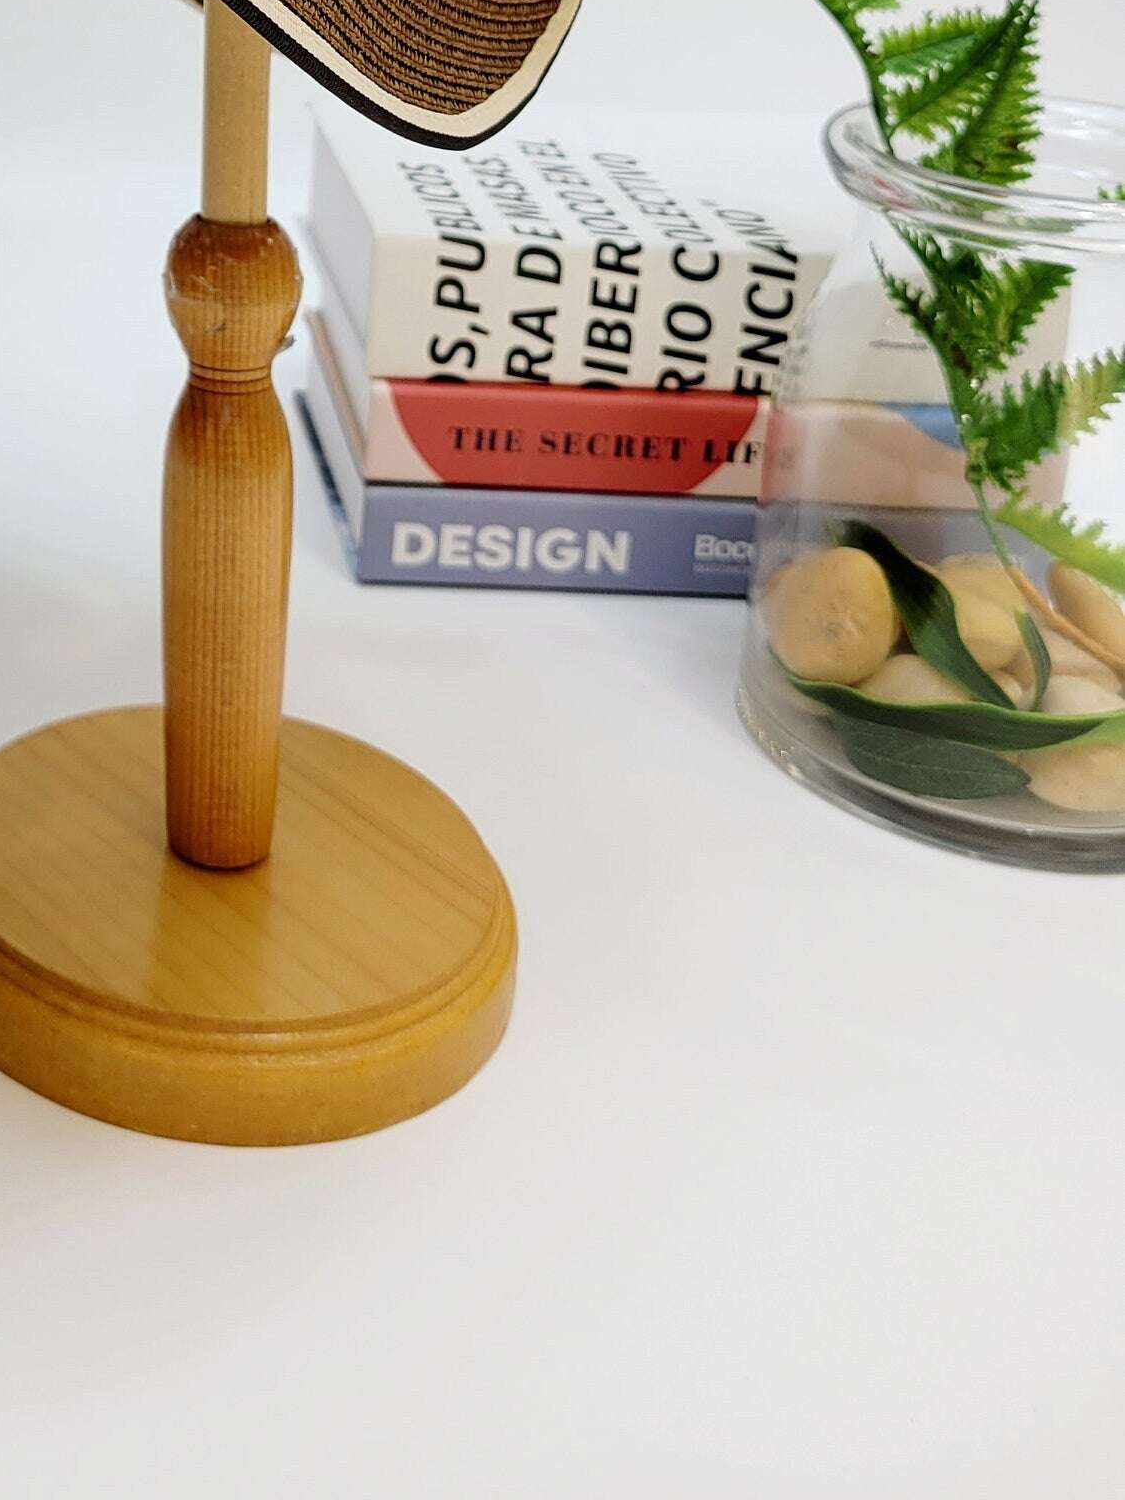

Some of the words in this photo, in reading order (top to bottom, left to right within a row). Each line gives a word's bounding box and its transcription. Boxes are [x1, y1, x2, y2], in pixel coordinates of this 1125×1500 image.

[510, 224, 563, 285] DE
[557, 190, 642, 388] IBERIOCO
[449, 426, 522, 452] THE
[538, 430, 686, 461] SECRET
[702, 438, 763, 464] LIF
[391, 521, 632, 574] DESIGN
